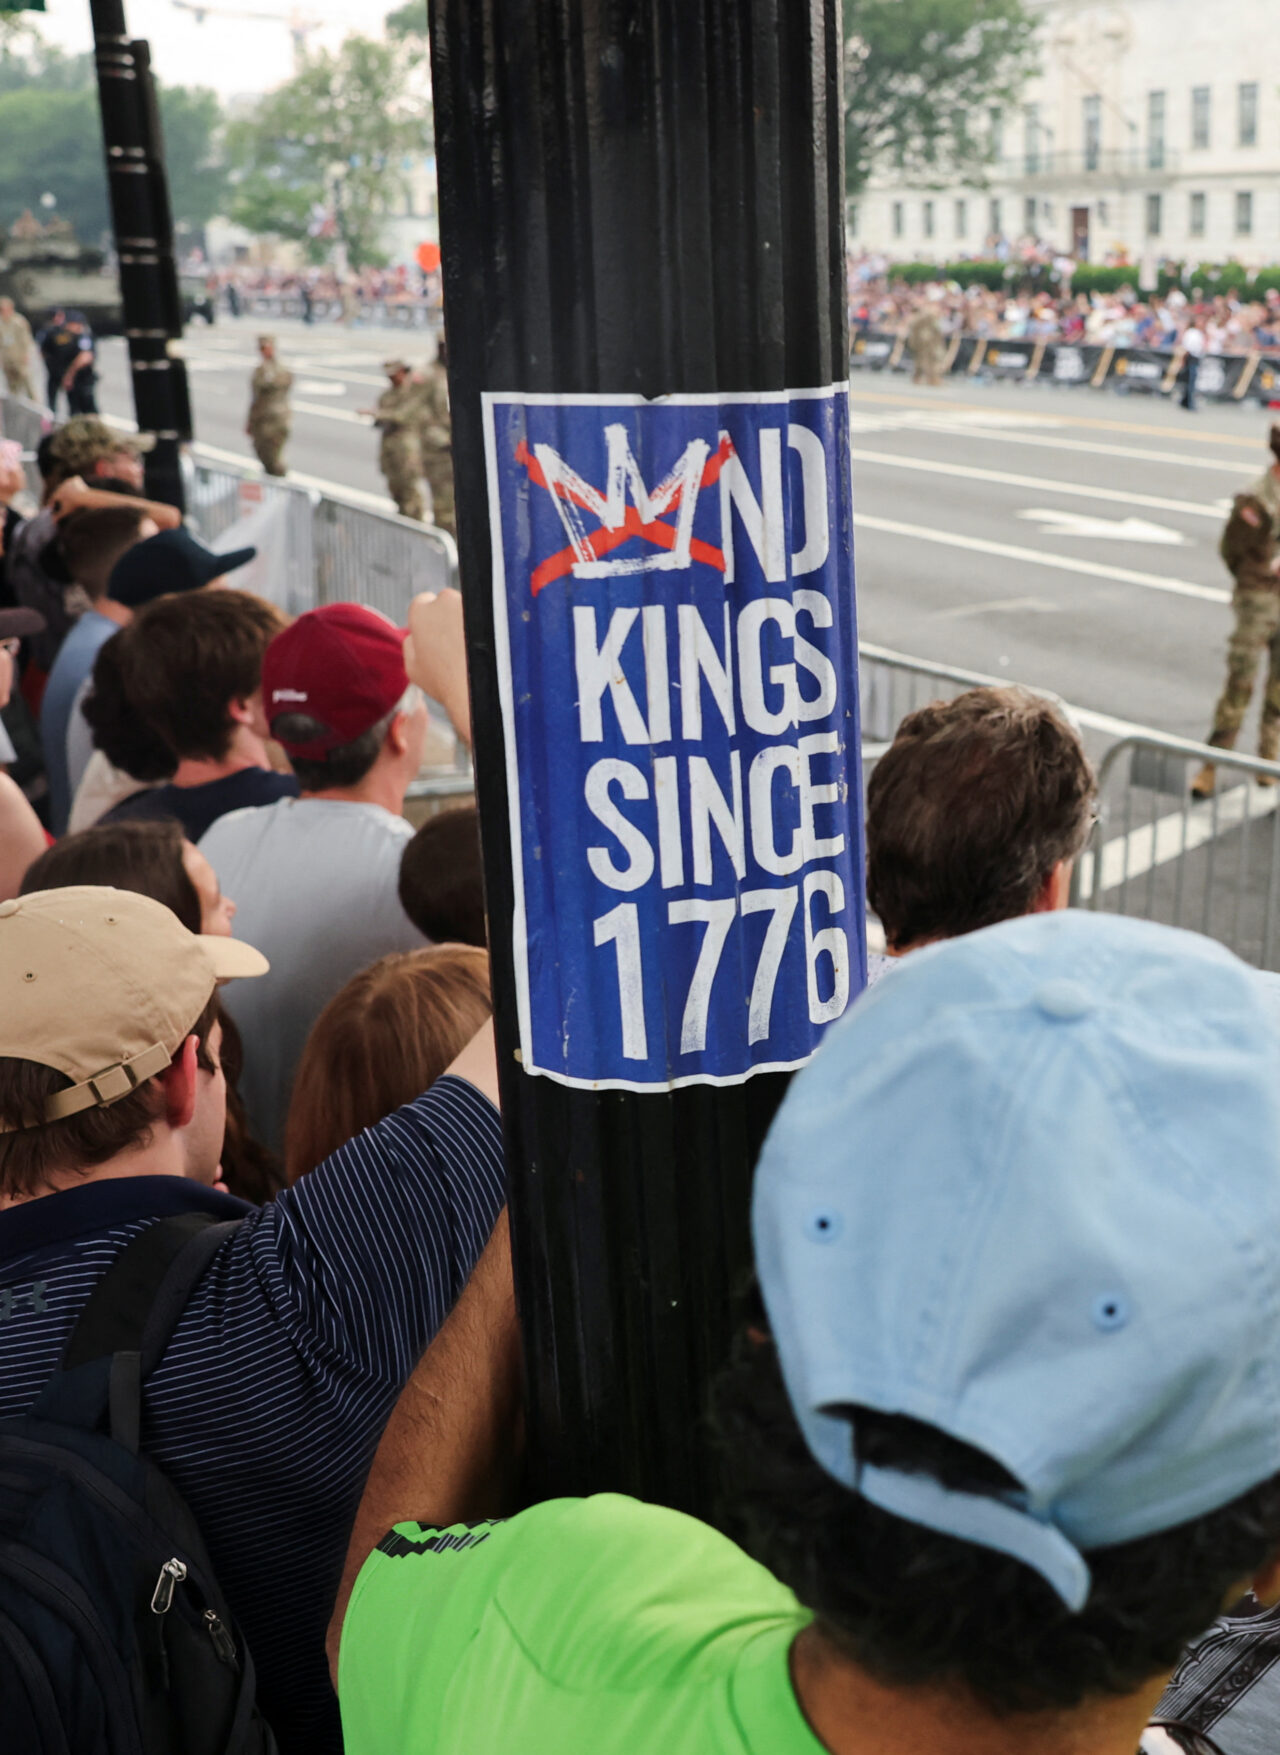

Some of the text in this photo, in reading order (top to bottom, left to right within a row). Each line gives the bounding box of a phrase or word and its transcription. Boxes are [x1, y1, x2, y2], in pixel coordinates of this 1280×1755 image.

[573, 588, 838, 745] KINGS
[584, 731, 845, 893] SINCE
[593, 870, 850, 1061] 1776
